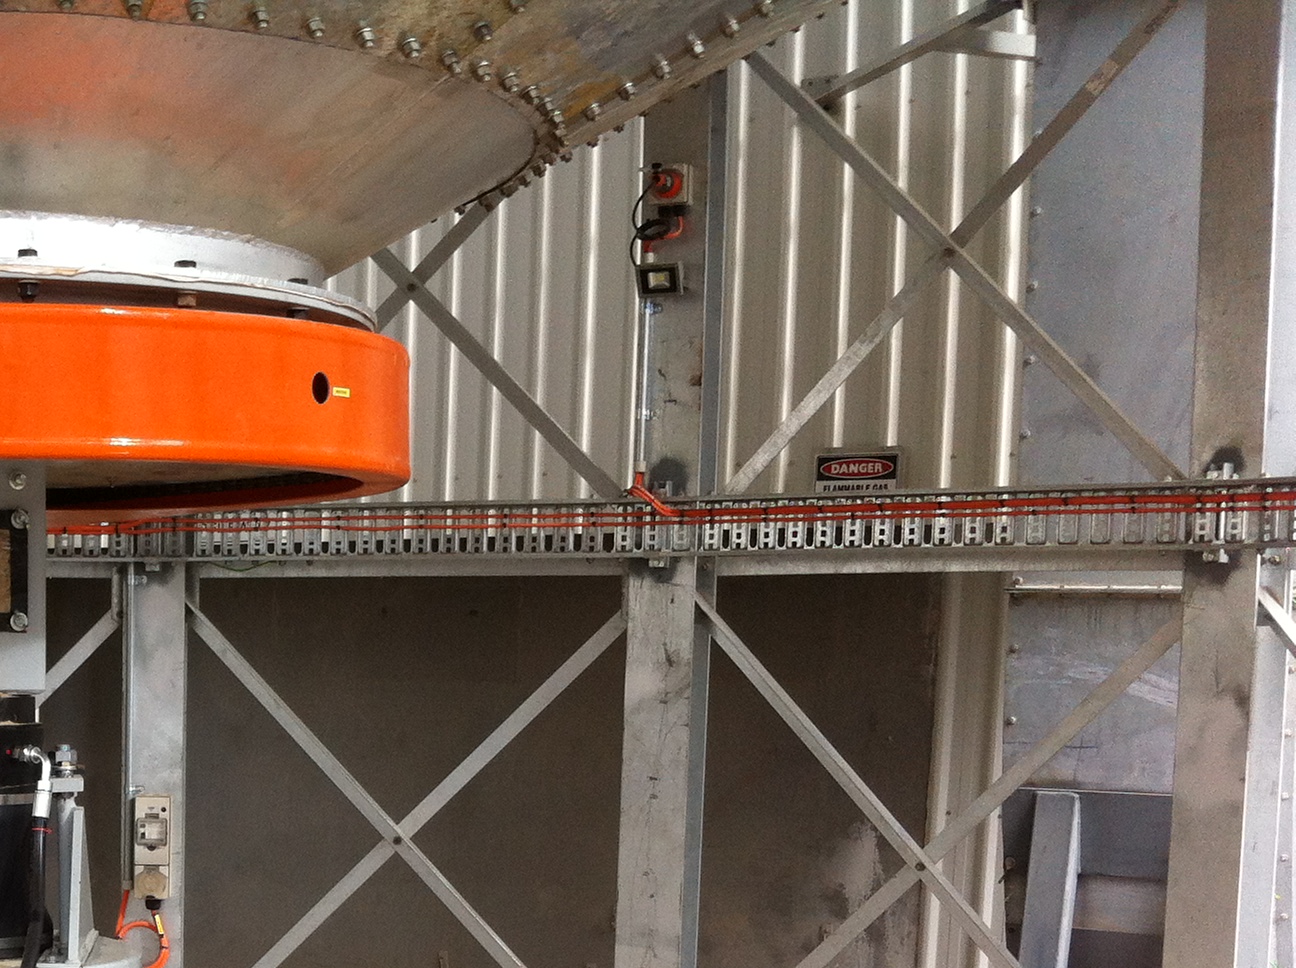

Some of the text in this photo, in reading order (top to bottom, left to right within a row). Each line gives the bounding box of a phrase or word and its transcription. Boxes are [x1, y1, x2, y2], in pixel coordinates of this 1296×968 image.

[830, 462, 883, 474] DANGER
[823, 483, 889, 492] FLAMMABLE GAS
